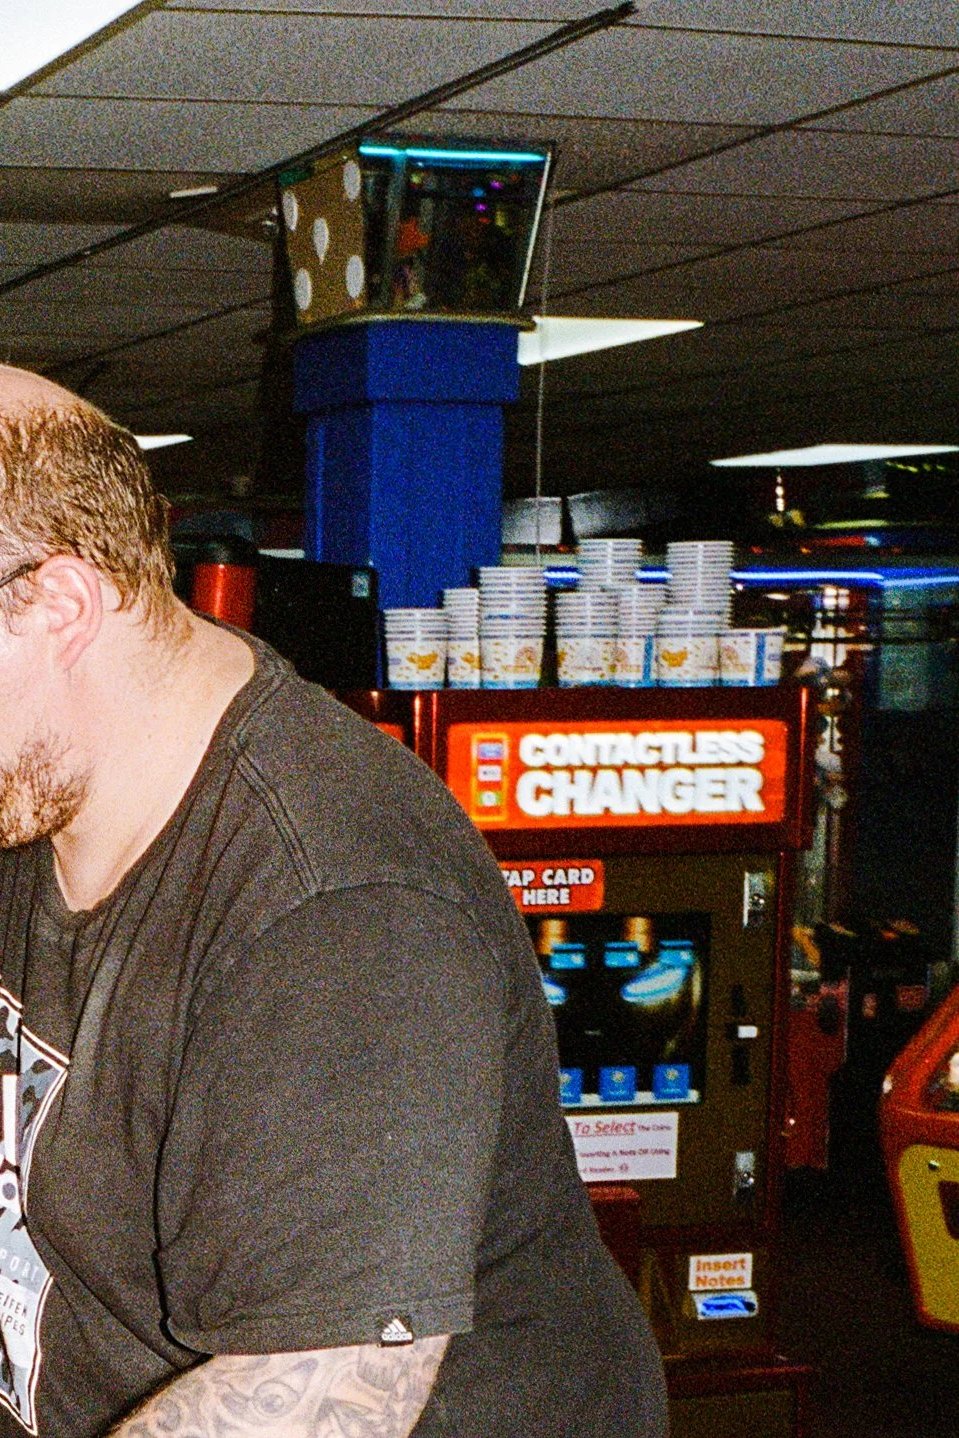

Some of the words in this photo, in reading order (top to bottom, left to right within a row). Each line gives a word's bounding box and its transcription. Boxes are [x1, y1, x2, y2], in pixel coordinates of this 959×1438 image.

[518, 730, 765, 767] CONTACTLESS
[515, 768, 766, 817] CHANGER
[541, 867, 595, 886] CARD
[522, 887, 571, 906] HERE
[594, 1120, 637, 1134] Select
[695, 1257, 747, 1272] Insert
[695, 1274, 746, 1288] Notes
